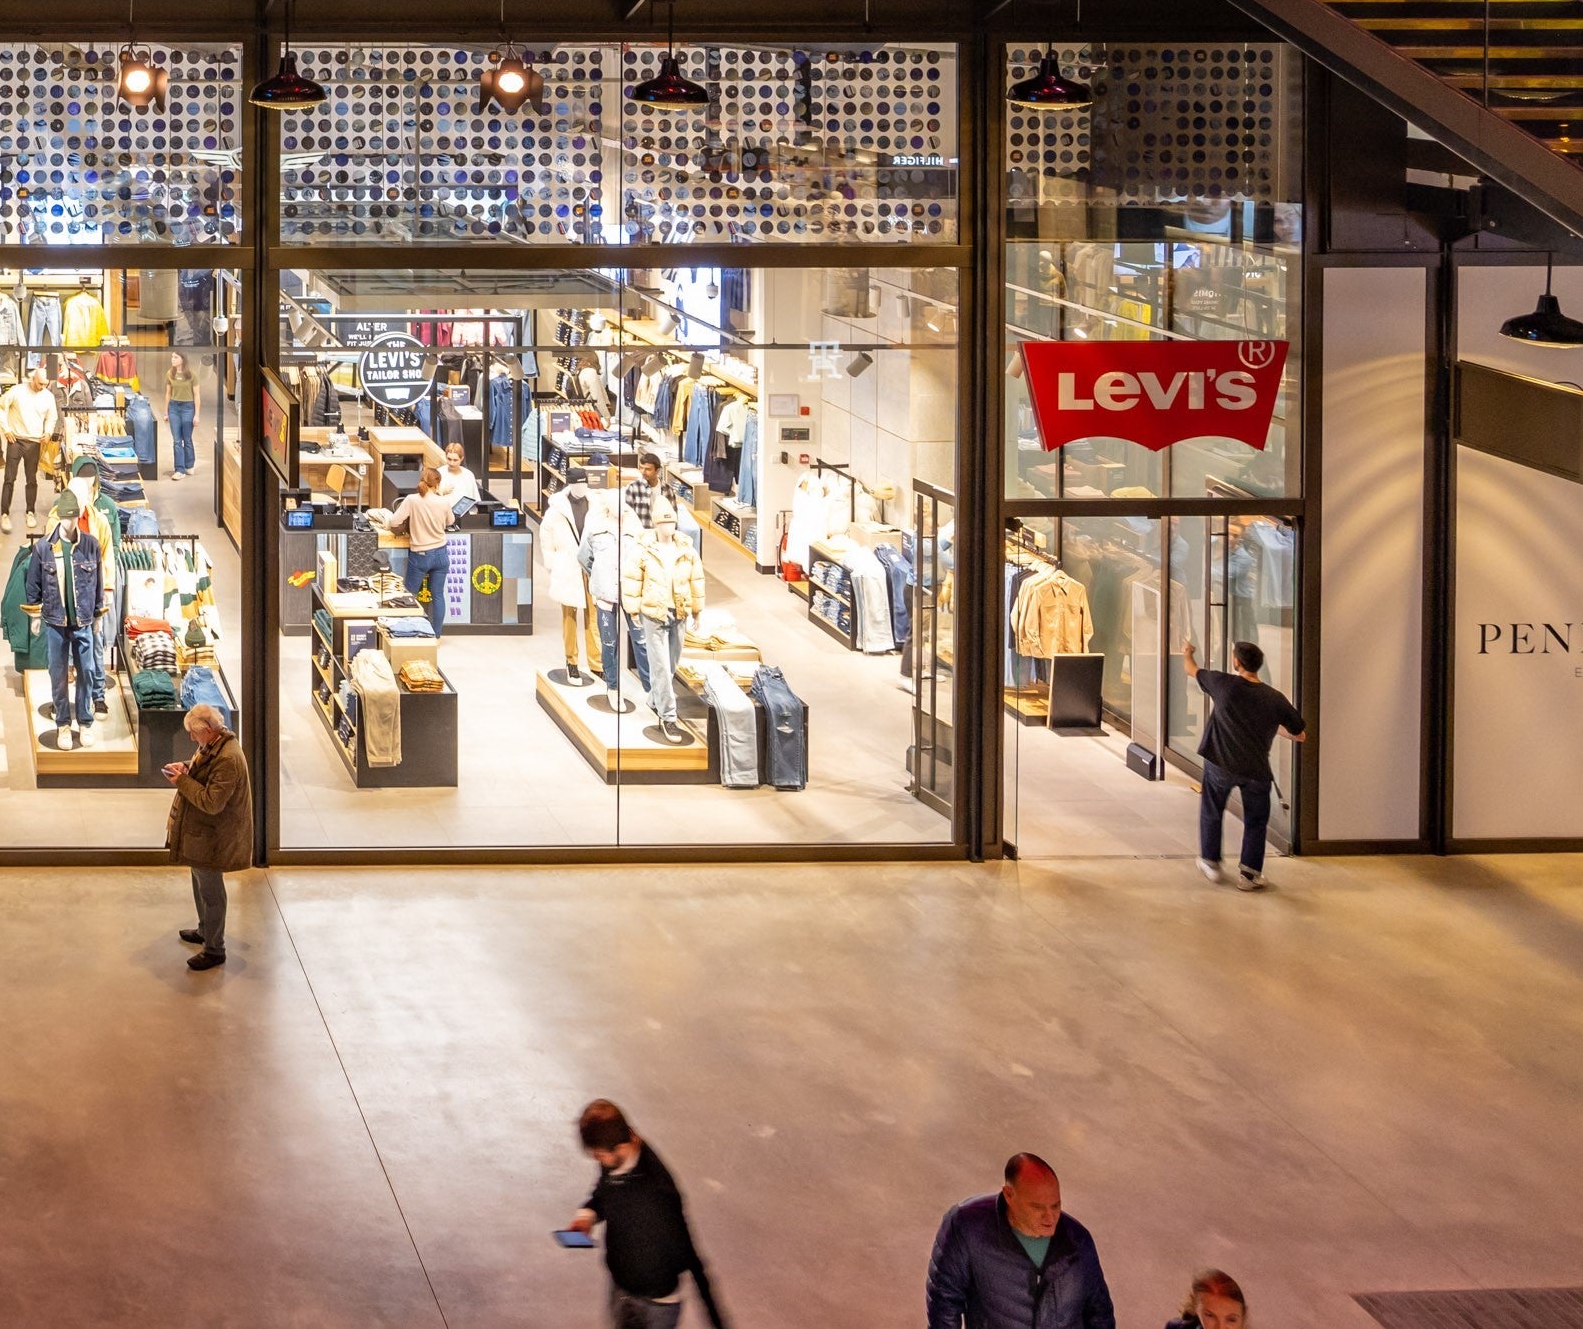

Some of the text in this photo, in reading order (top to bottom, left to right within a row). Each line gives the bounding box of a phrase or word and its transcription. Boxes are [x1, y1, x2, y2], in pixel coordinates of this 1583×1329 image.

[366, 369, 422, 380] TAILOR SHO
[1478, 623, 1583, 654] PEN
